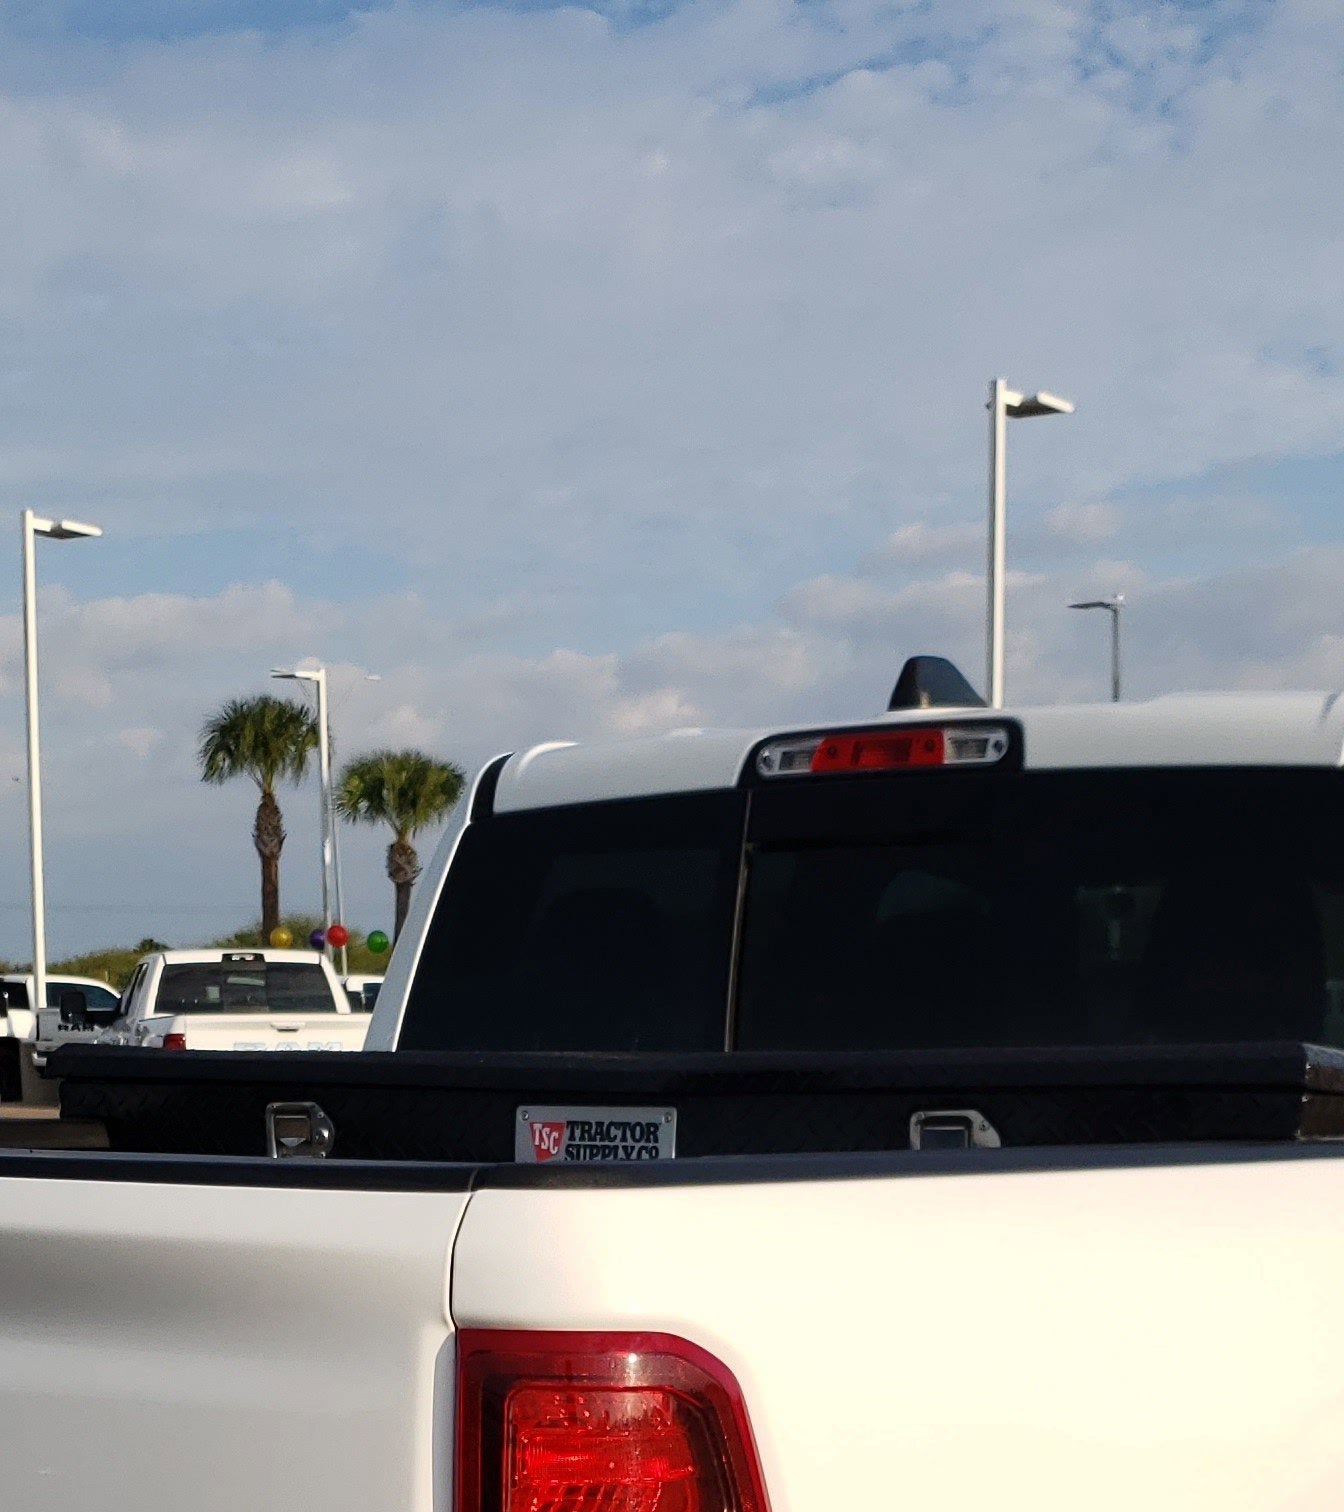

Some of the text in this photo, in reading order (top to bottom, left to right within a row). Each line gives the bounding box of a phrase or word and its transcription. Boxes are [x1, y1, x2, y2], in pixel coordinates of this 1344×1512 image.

[533, 1120, 660, 1155] TSC TRACTOR
[564, 1143, 635, 1161] SUPPLY
